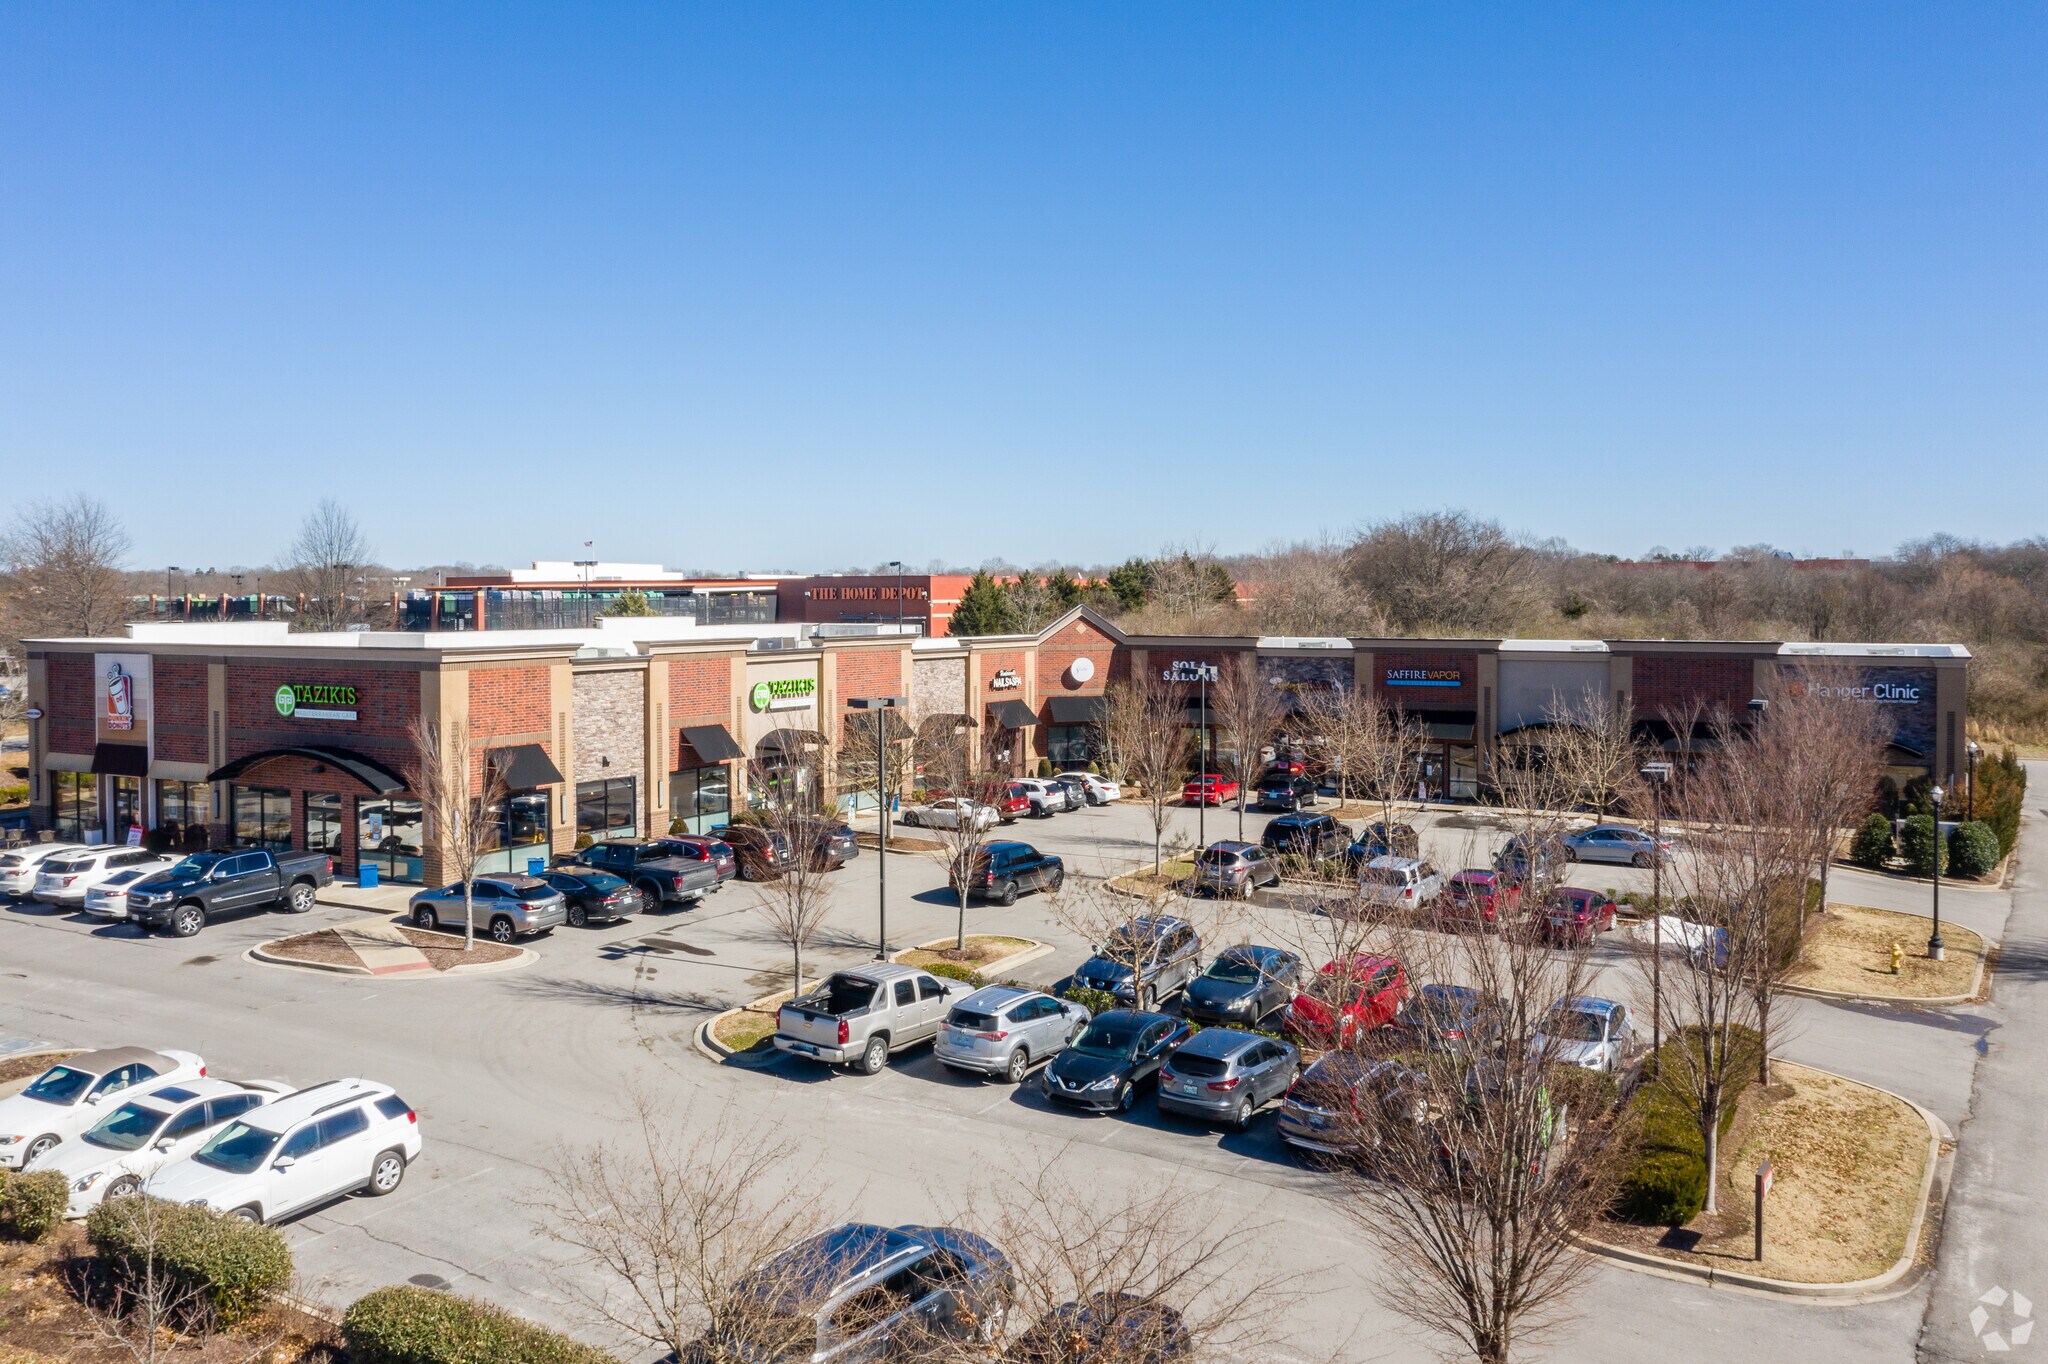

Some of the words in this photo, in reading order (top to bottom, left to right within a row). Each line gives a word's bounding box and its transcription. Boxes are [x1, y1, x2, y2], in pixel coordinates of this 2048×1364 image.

[811, 587, 837, 600] THE
[841, 587, 877, 600] HOME
[881, 586, 924, 600] DEPOT
[1172, 661, 1207, 670] SOLA
[1387, 670, 1427, 679] SAFFIRE
[1427, 671, 1460, 679] VAPOR
[1873, 684, 1919, 699] Clinic
